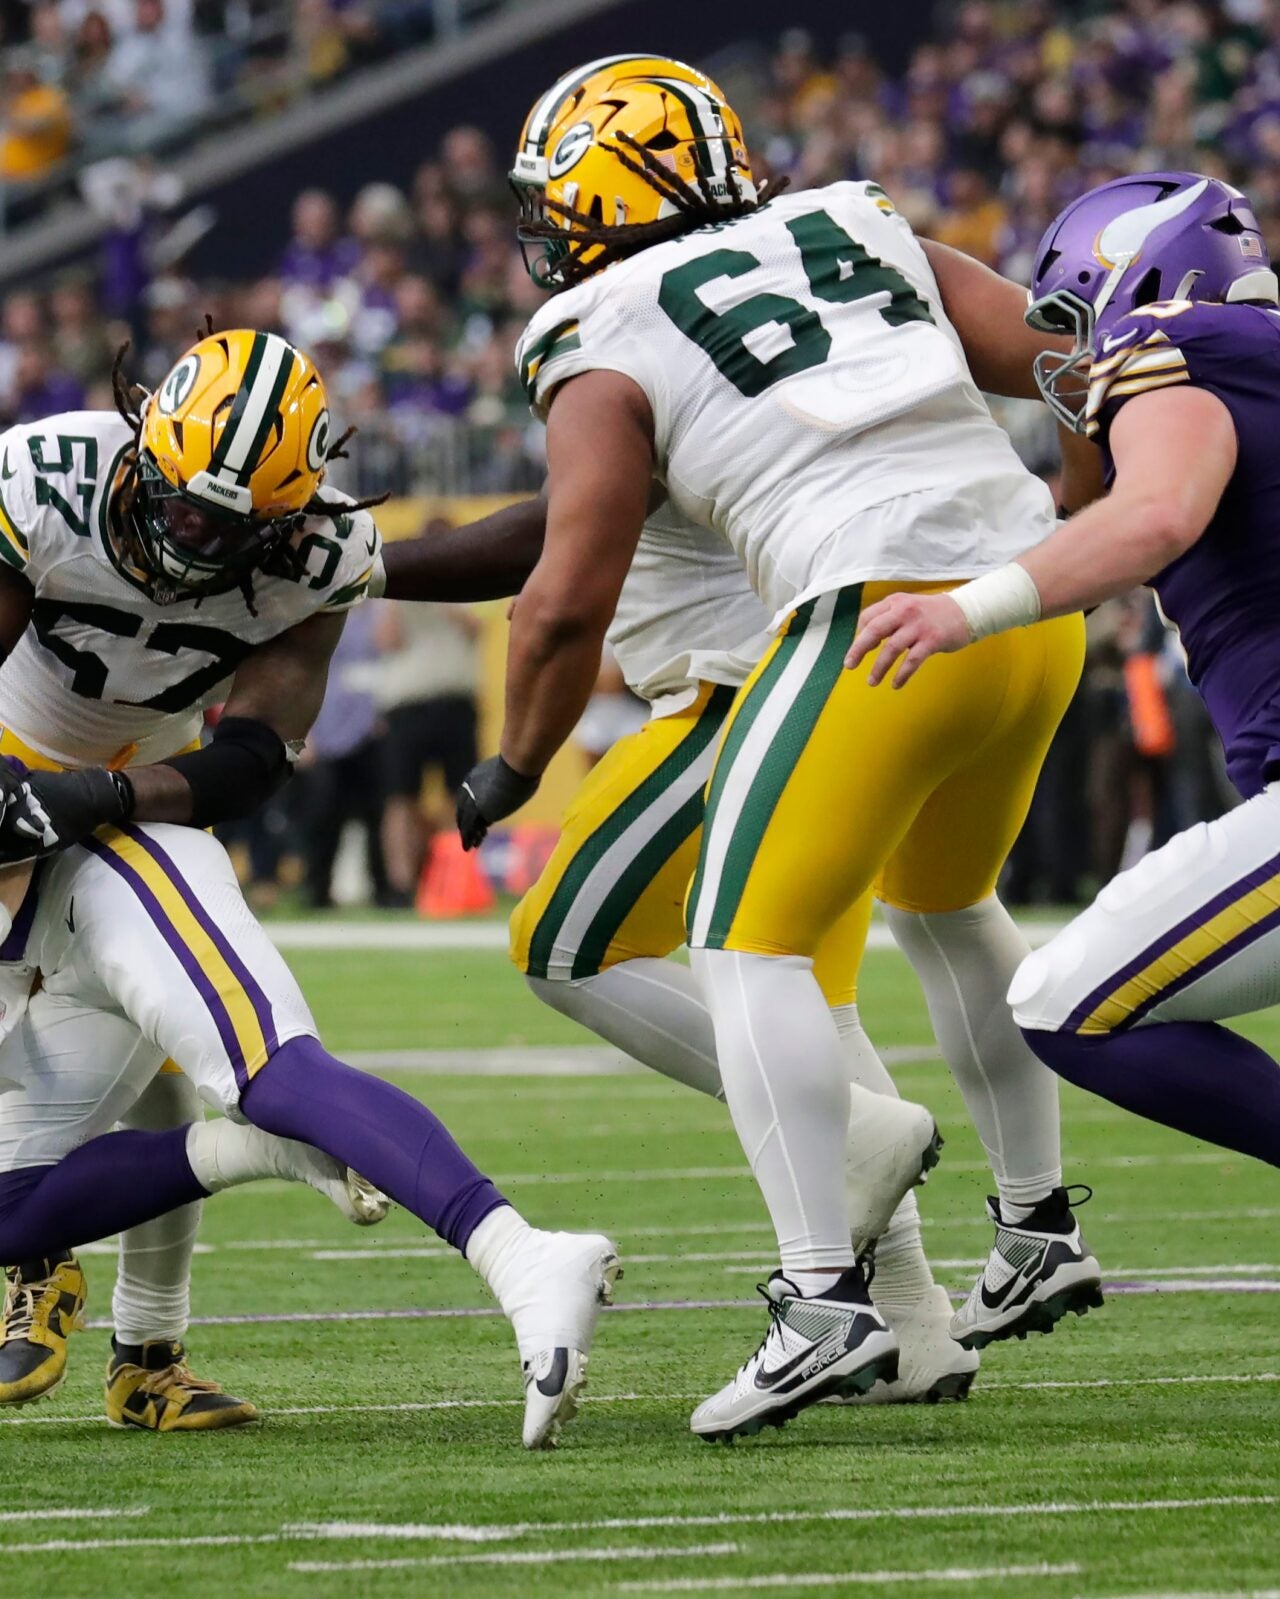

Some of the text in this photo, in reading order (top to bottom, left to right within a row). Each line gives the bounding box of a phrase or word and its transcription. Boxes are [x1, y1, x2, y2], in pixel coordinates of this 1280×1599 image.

[658, 208, 937, 398] 64
[26, 433, 98, 538] 57
[207, 481, 239, 500] PACKERS
[31, 597, 258, 714] 57
[801, 1345, 848, 1380] FORCE
